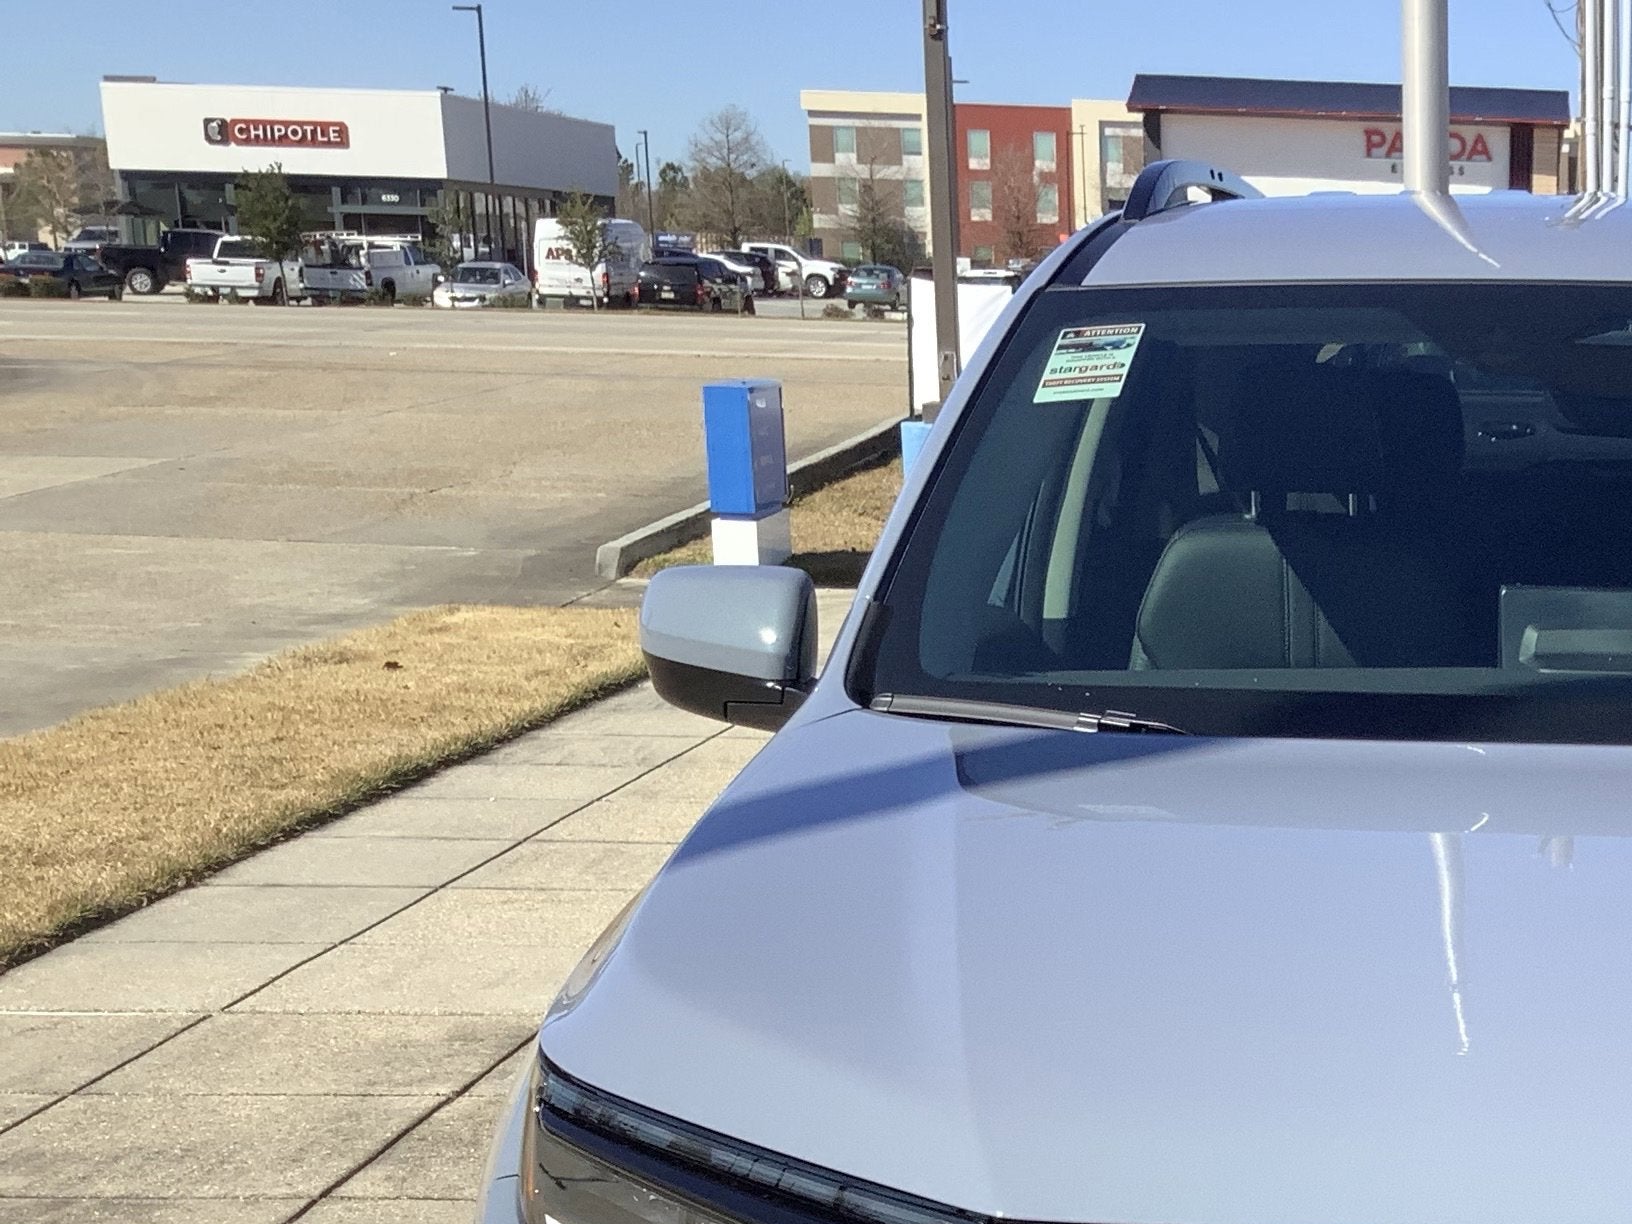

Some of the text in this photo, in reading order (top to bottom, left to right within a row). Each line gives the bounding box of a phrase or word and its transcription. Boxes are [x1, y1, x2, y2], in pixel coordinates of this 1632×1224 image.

[234, 123, 341, 142] CHIPOTLE
[1364, 128, 1493, 162] PADA
[1083, 327, 1139, 337] ATTENTION
